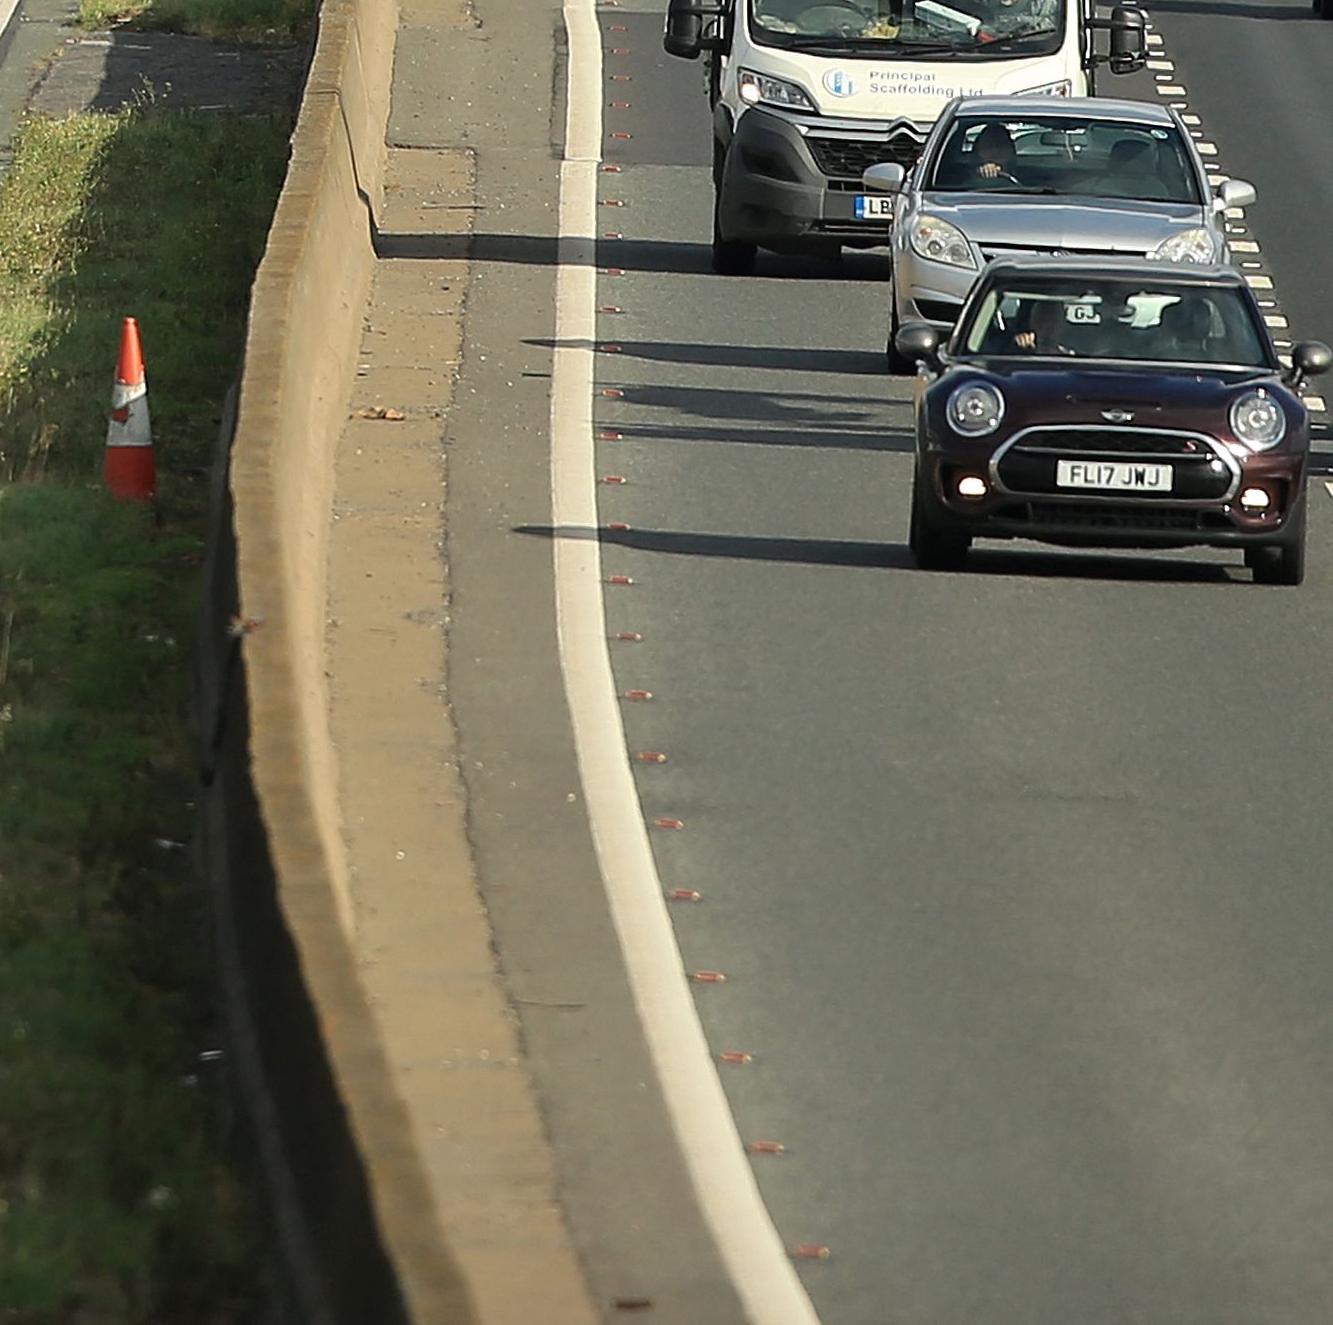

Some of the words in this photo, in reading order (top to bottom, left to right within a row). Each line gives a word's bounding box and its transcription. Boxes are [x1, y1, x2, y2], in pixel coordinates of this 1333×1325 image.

[868, 70, 936, 83] Principal
[868, 82, 955, 99] Scaffolding
[1069, 464, 1116, 484] FL17
[1121, 466, 1161, 486] JWJ
